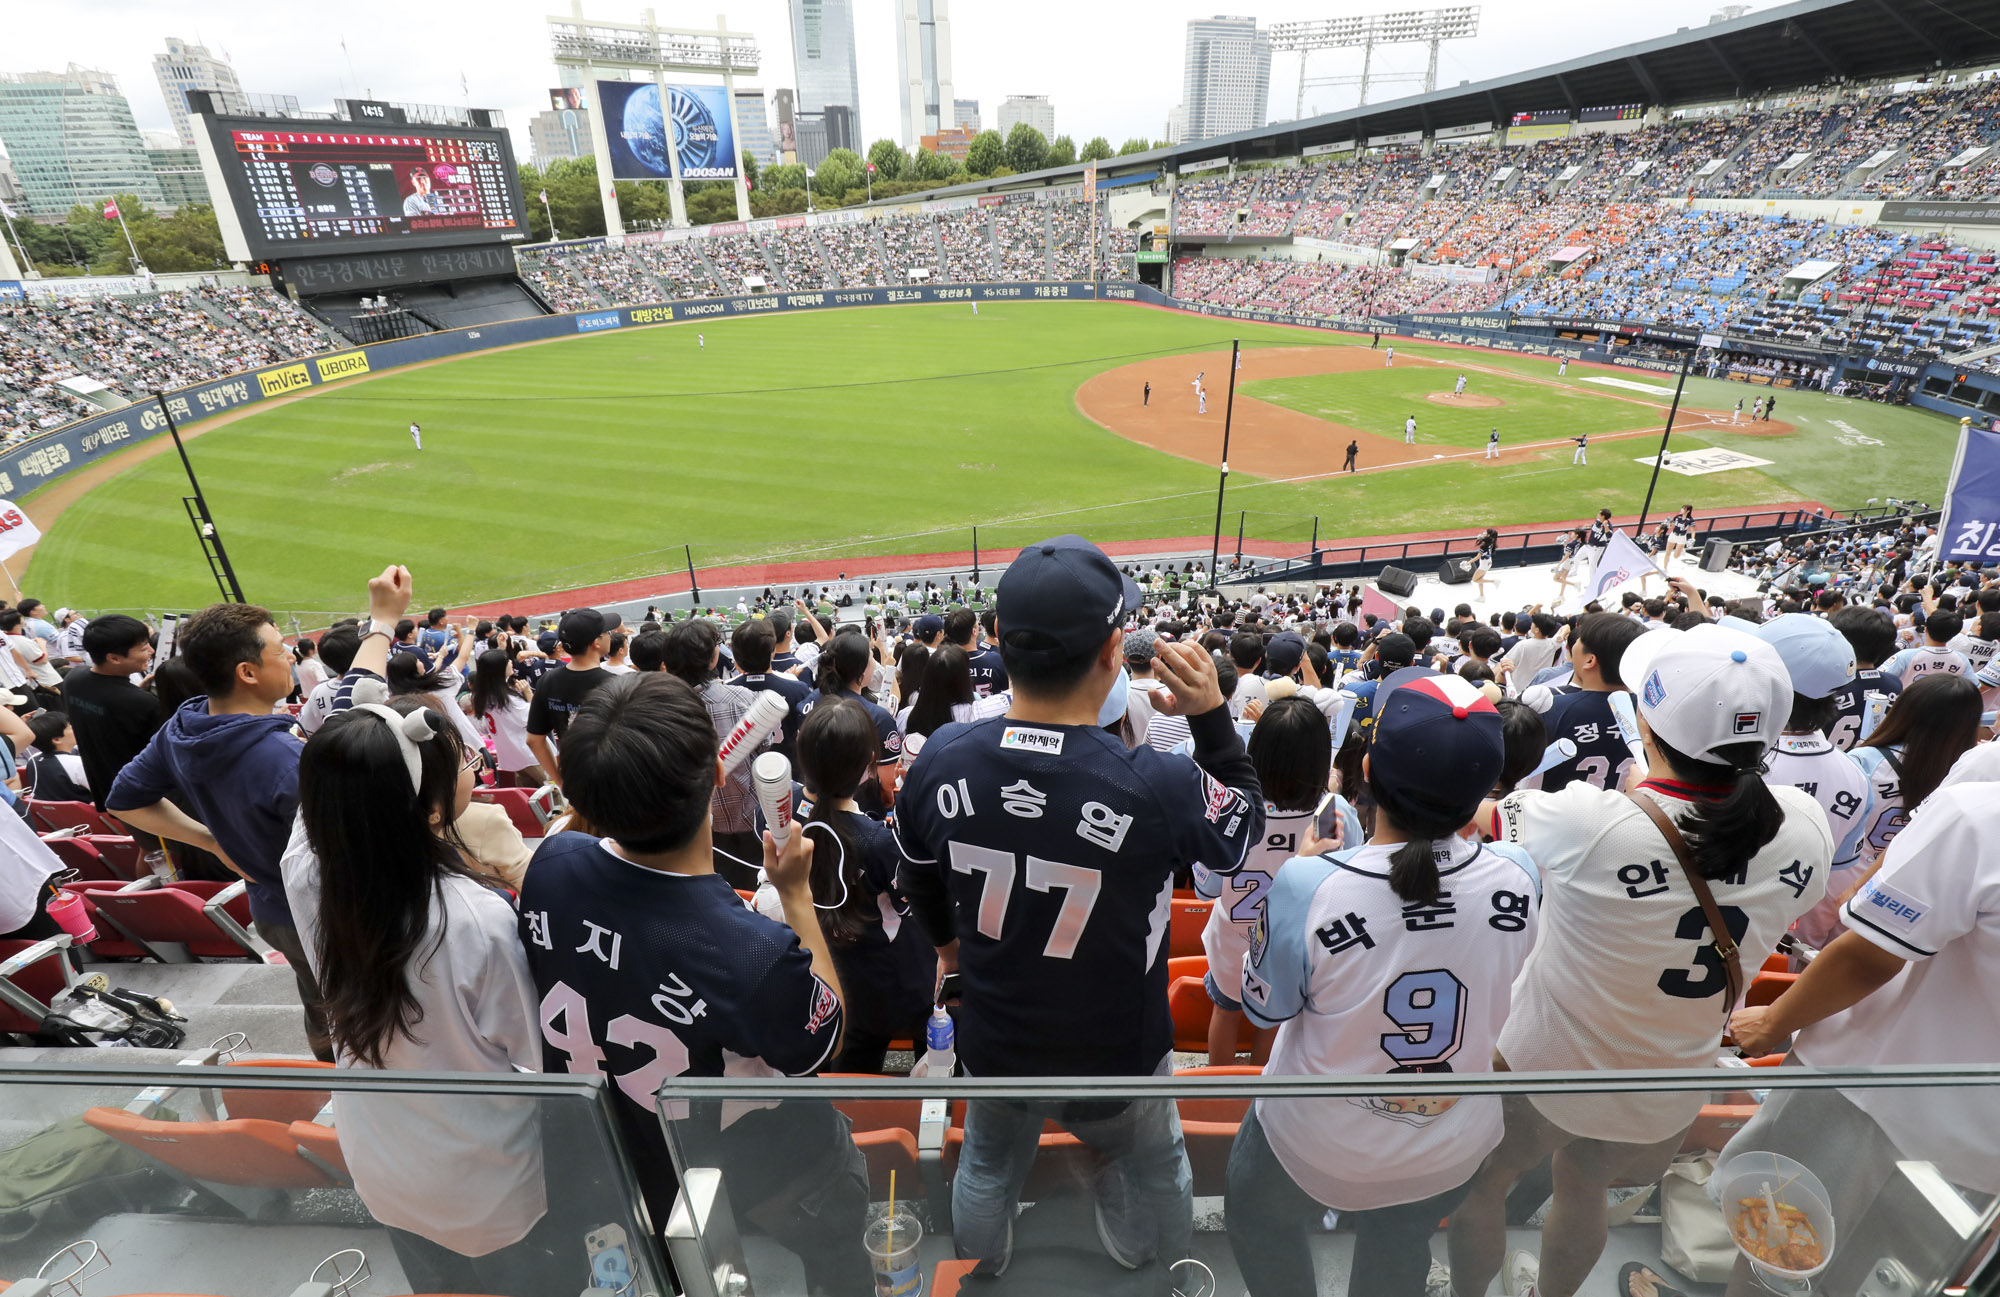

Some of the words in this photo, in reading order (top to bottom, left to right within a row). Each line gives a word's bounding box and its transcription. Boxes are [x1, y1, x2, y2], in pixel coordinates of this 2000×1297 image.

[361, 105, 384, 117] 14:15
[240, 133, 265, 141] TEAM
[342, 136, 349, 144] 6
[413, 138, 422, 146] 12
[251, 152, 266, 160] LG
[683, 168, 734, 177] DOOSAN
[421, 248, 505, 274] 한국경제TV
[295, 256, 407, 286] 한국경제신문
[835, 292, 874, 303] 한국경제TV
[1034, 286, 1068, 297] 키움증권
[747, 297, 779, 310] 대보건설
[787, 294, 824, 306] 치킨마루
[630, 306, 674, 323] 대방건설
[684, 303, 724, 316] HANCOM
[585, 315, 619, 328] 도미노피자
[1460, 316, 1507, 329] 충남혁신도시
[319, 355, 367, 377] UBORA
[1878, 361, 1894, 373] IBK
[1895, 364, 1918, 376] 캐피탈
[197, 381, 249, 412] 현대해상
[1970, 645, 1995, 657] PARK
[1913, 661, 1960, 674] 이병헌
[1018, 732, 1061, 750] 대화제약
[936, 777, 1134, 852] 이승엽
[948, 840, 1101, 959] 77
[1656, 904, 1750, 999] 3
[1380, 968, 1468, 1066] 9
[539, 979, 691, 1114] 42
